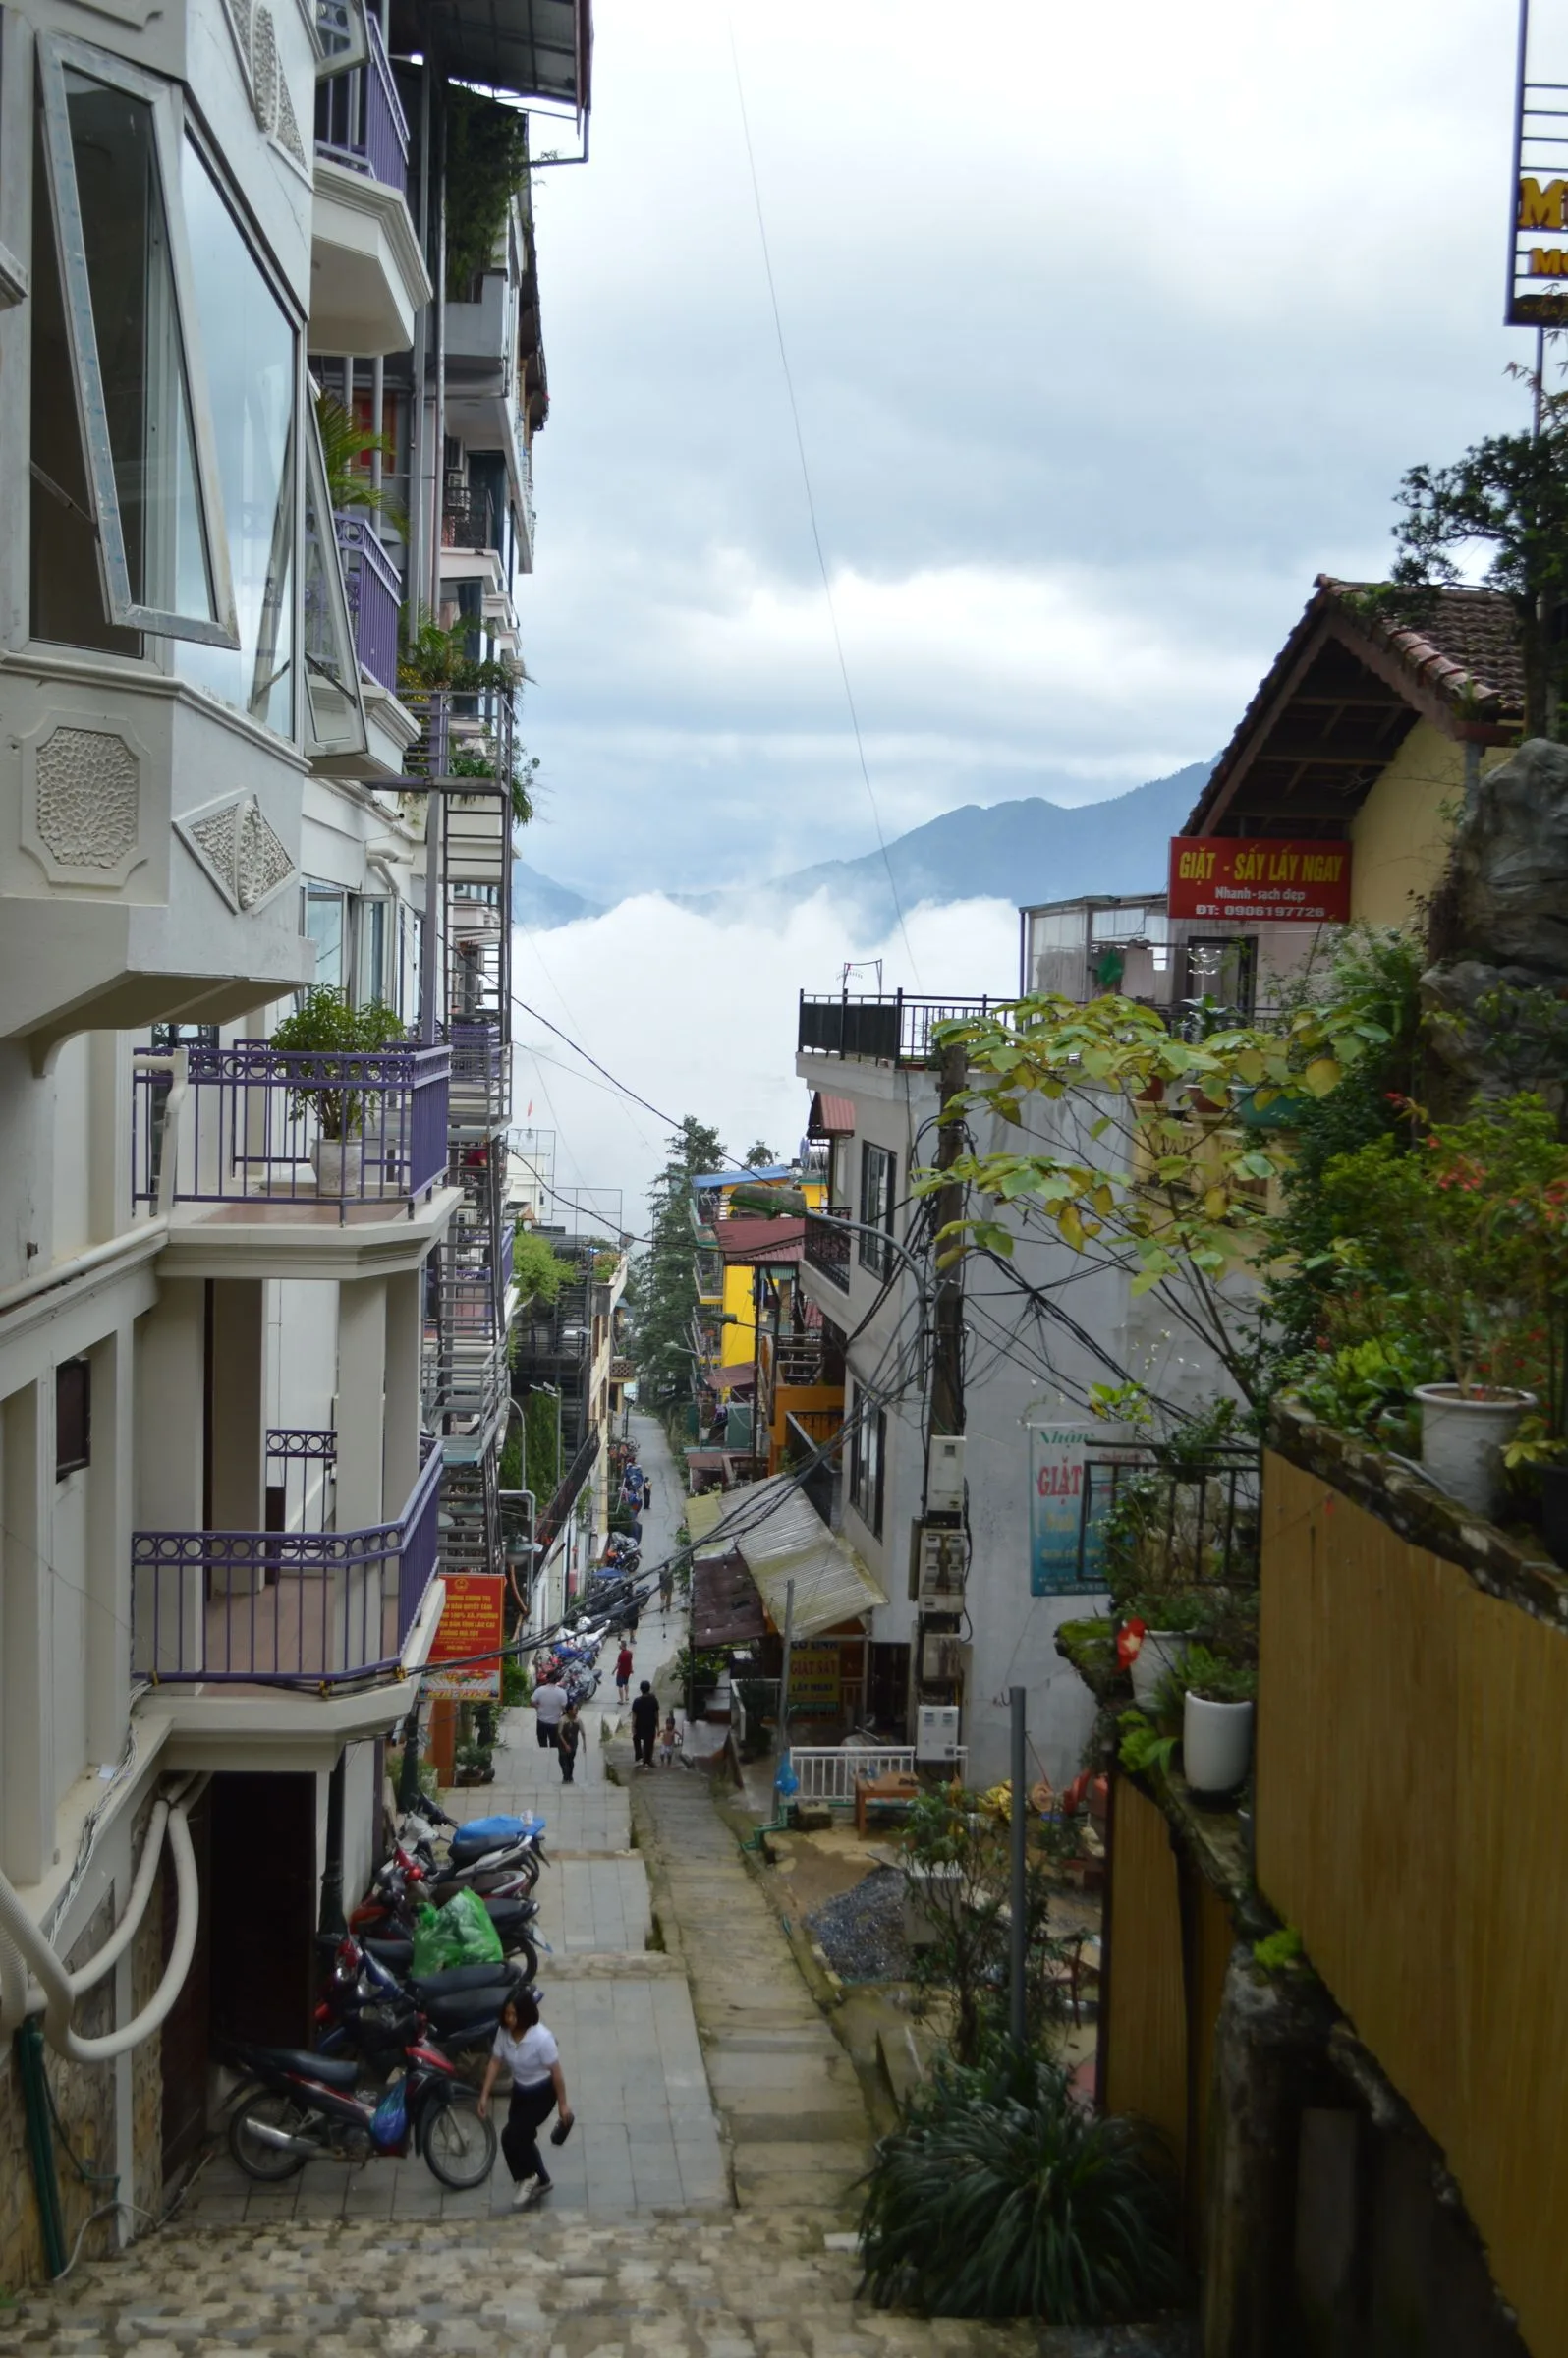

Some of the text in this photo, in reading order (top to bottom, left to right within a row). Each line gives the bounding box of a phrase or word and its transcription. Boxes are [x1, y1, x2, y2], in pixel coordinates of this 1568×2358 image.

[1179, 847, 1216, 885] GIẶT
[1234, 843, 1265, 881] SẤY
[1268, 843, 1300, 881] LẤY
[1302, 855, 1344, 883] NGAY
[1037, 1456, 1083, 1505] GIẶT
